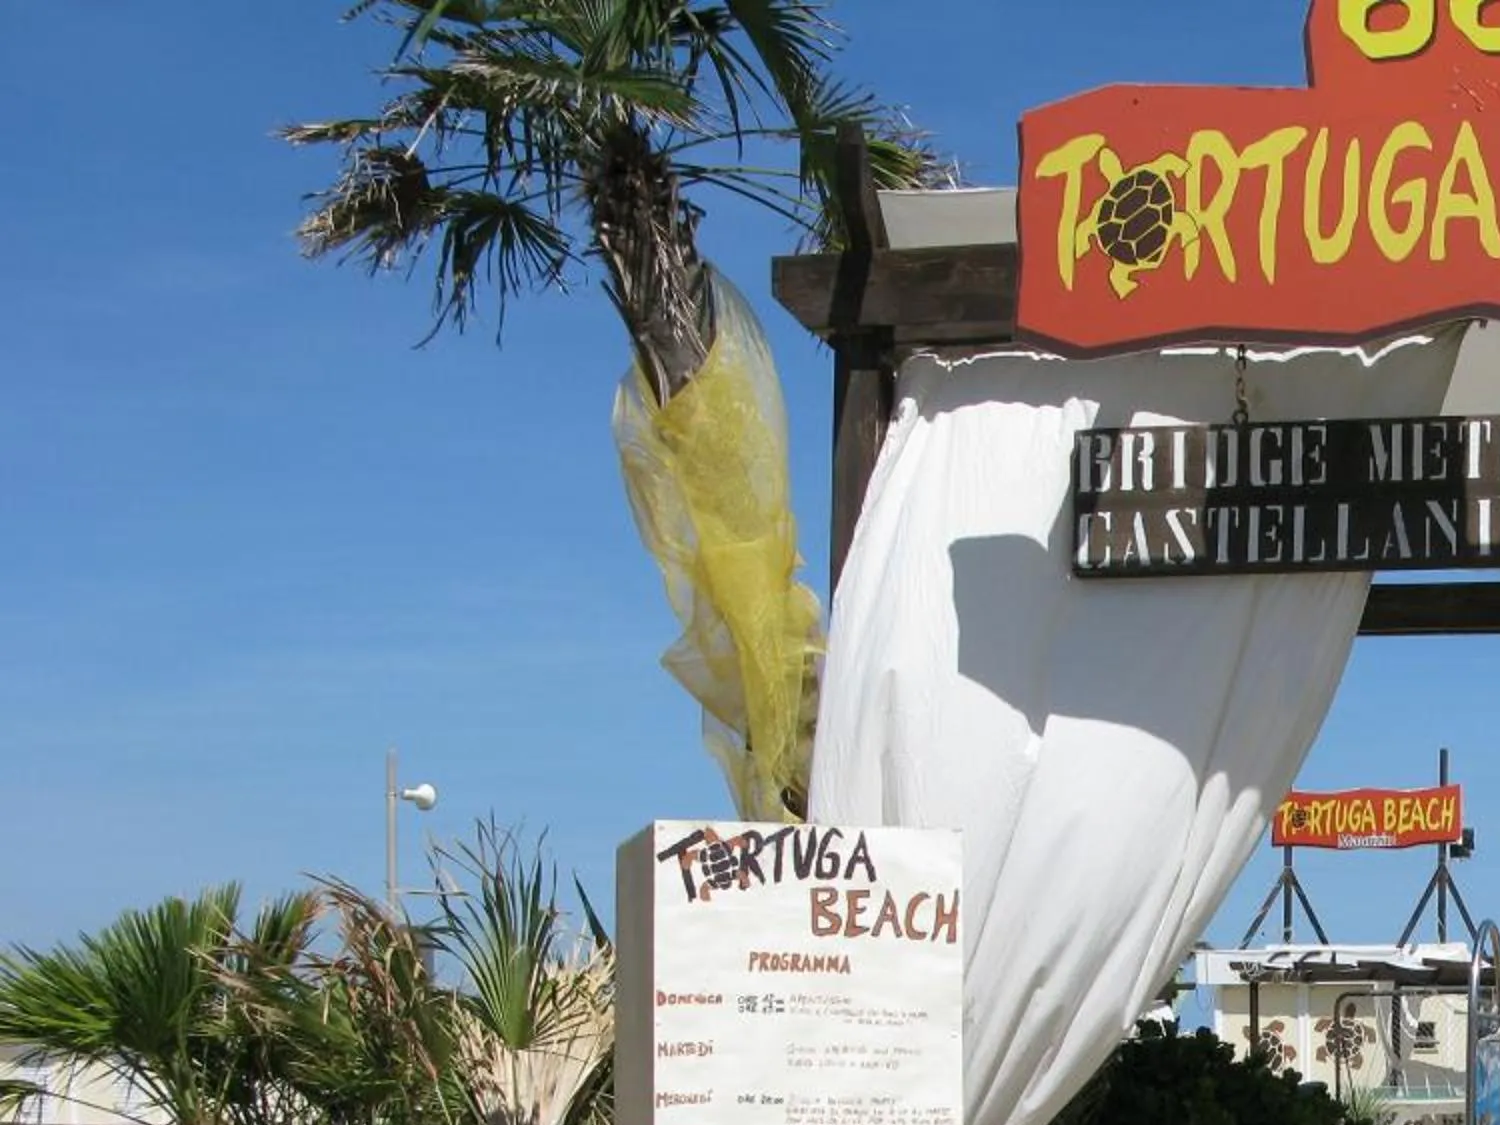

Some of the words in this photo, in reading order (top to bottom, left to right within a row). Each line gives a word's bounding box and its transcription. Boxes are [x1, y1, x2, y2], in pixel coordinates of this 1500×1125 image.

[1077, 425, 1328, 493] BRIDGE
[1077, 499, 1493, 569] CASTELLANI
[1384, 796, 1456, 834] BEACH
[810, 887, 960, 944] BEACH
[748, 951, 852, 974] PROGRAMMA
